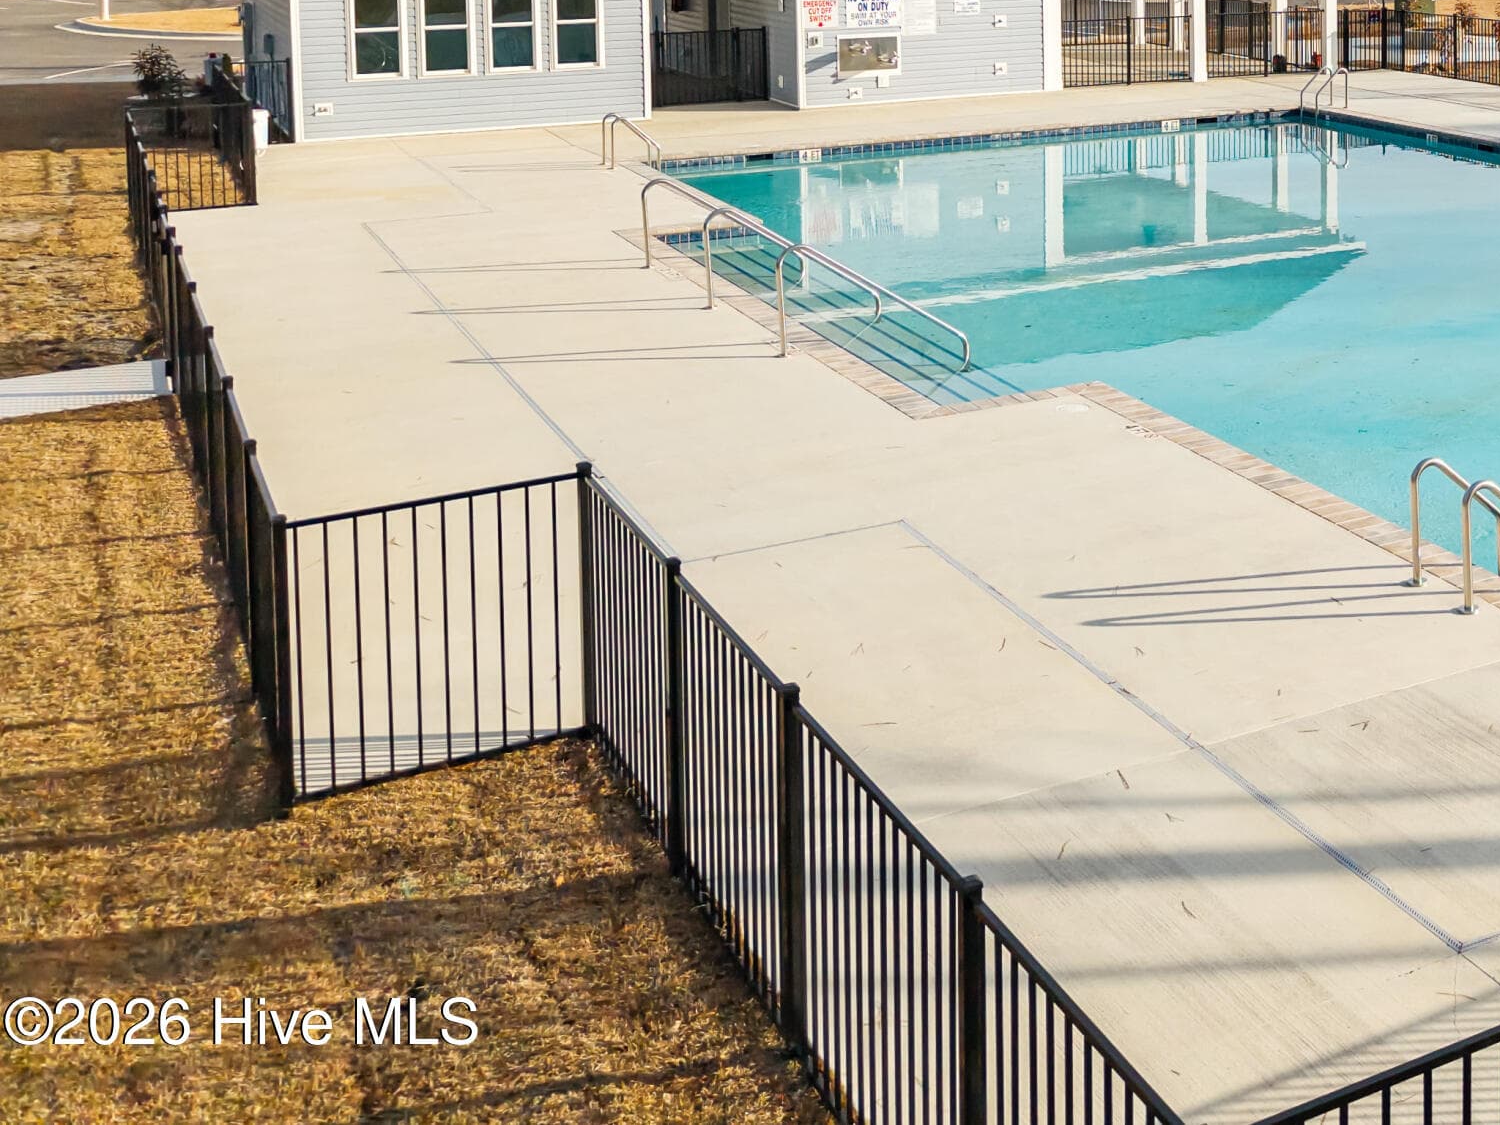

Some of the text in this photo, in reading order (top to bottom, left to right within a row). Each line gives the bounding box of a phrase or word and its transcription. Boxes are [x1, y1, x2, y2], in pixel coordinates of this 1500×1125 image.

[803, 0, 837, 8] EMERGENCY
[857, 1, 889, 12] ON DUTY
[809, 15, 832, 23] SWITCH
[850, 12, 867, 20] SWIM
[880, 11, 897, 19] YOUR
[857, 18, 889, 27] OWN RISK
